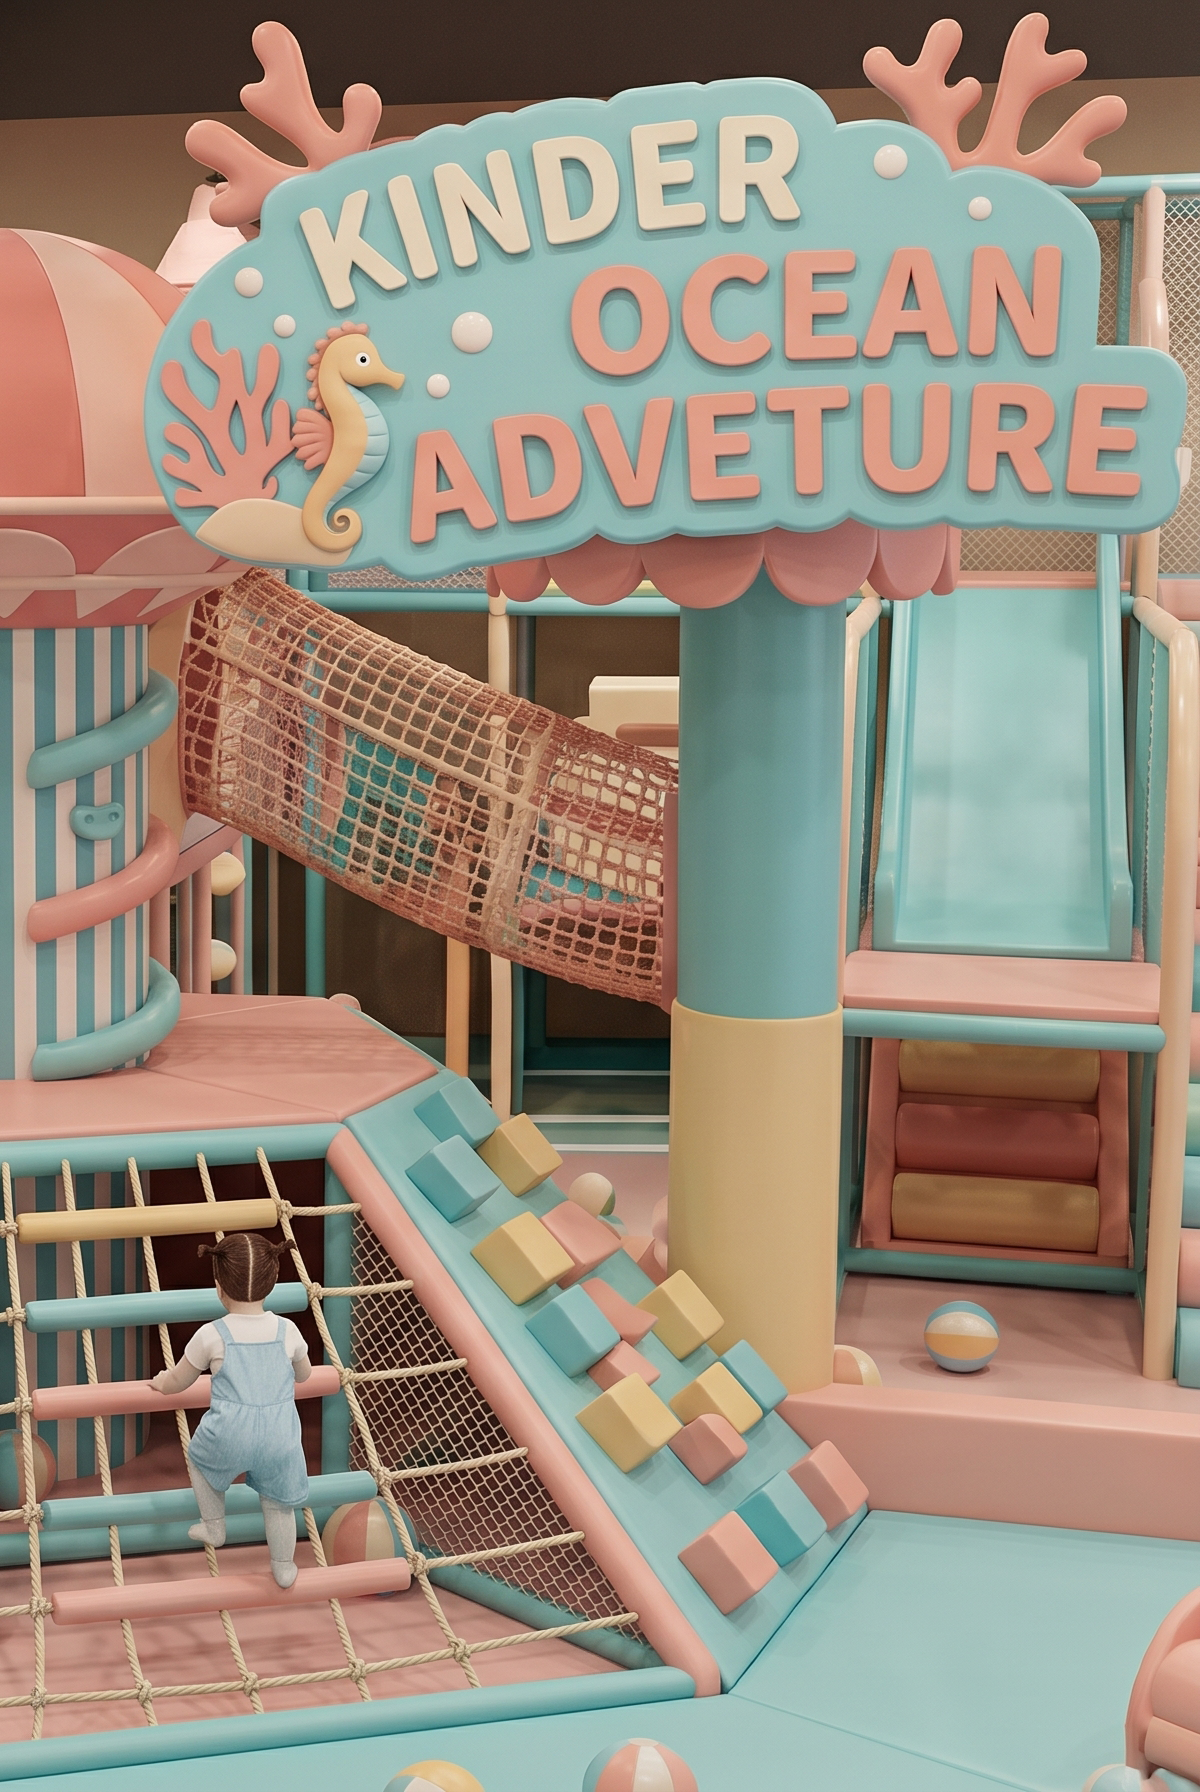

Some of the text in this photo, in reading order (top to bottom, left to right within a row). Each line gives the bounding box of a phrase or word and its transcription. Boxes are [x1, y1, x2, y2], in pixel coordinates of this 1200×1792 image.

[300, 115, 800, 310] KINDER
[570, 246, 1062, 377] OCEAN
[409, 383, 1149, 544] ADVETURE
